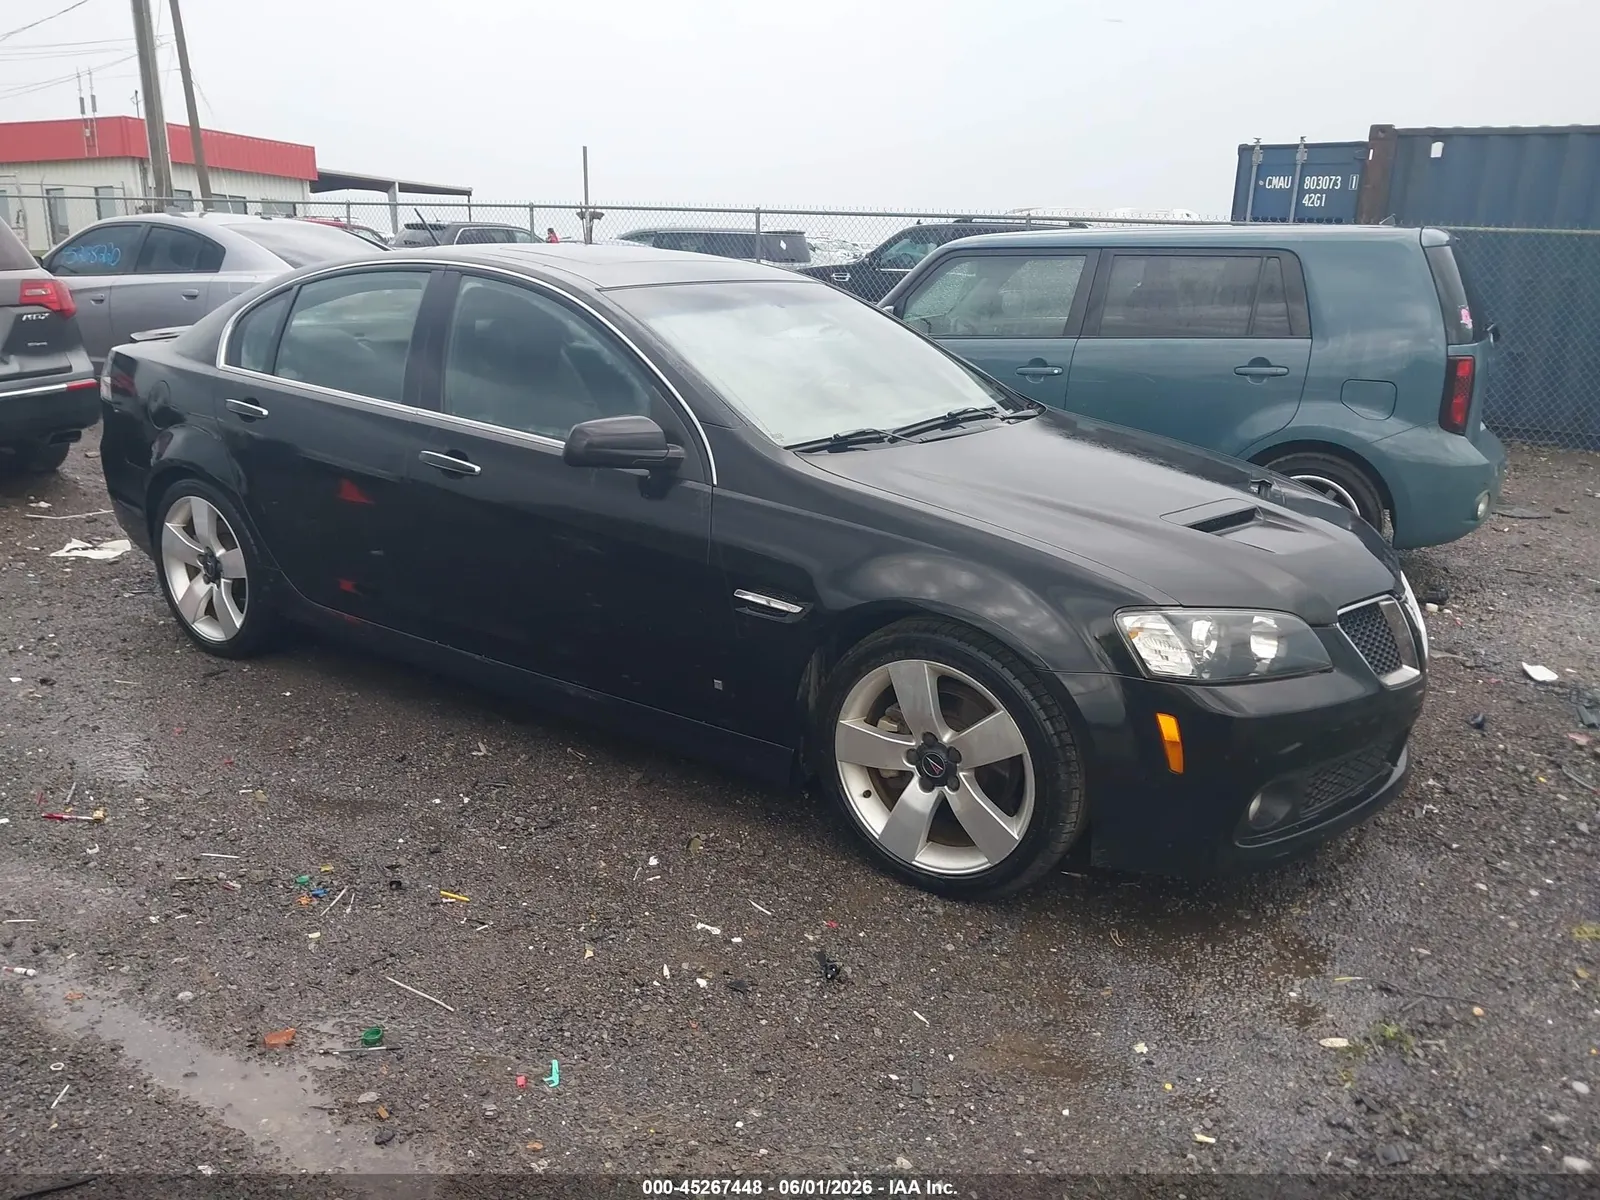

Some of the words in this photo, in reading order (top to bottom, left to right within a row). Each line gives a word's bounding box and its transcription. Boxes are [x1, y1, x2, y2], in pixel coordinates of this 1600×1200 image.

[1265, 175, 1292, 189] CMAU
[1303, 175, 1342, 190] 803073
[1302, 193, 1326, 207] 42G1
